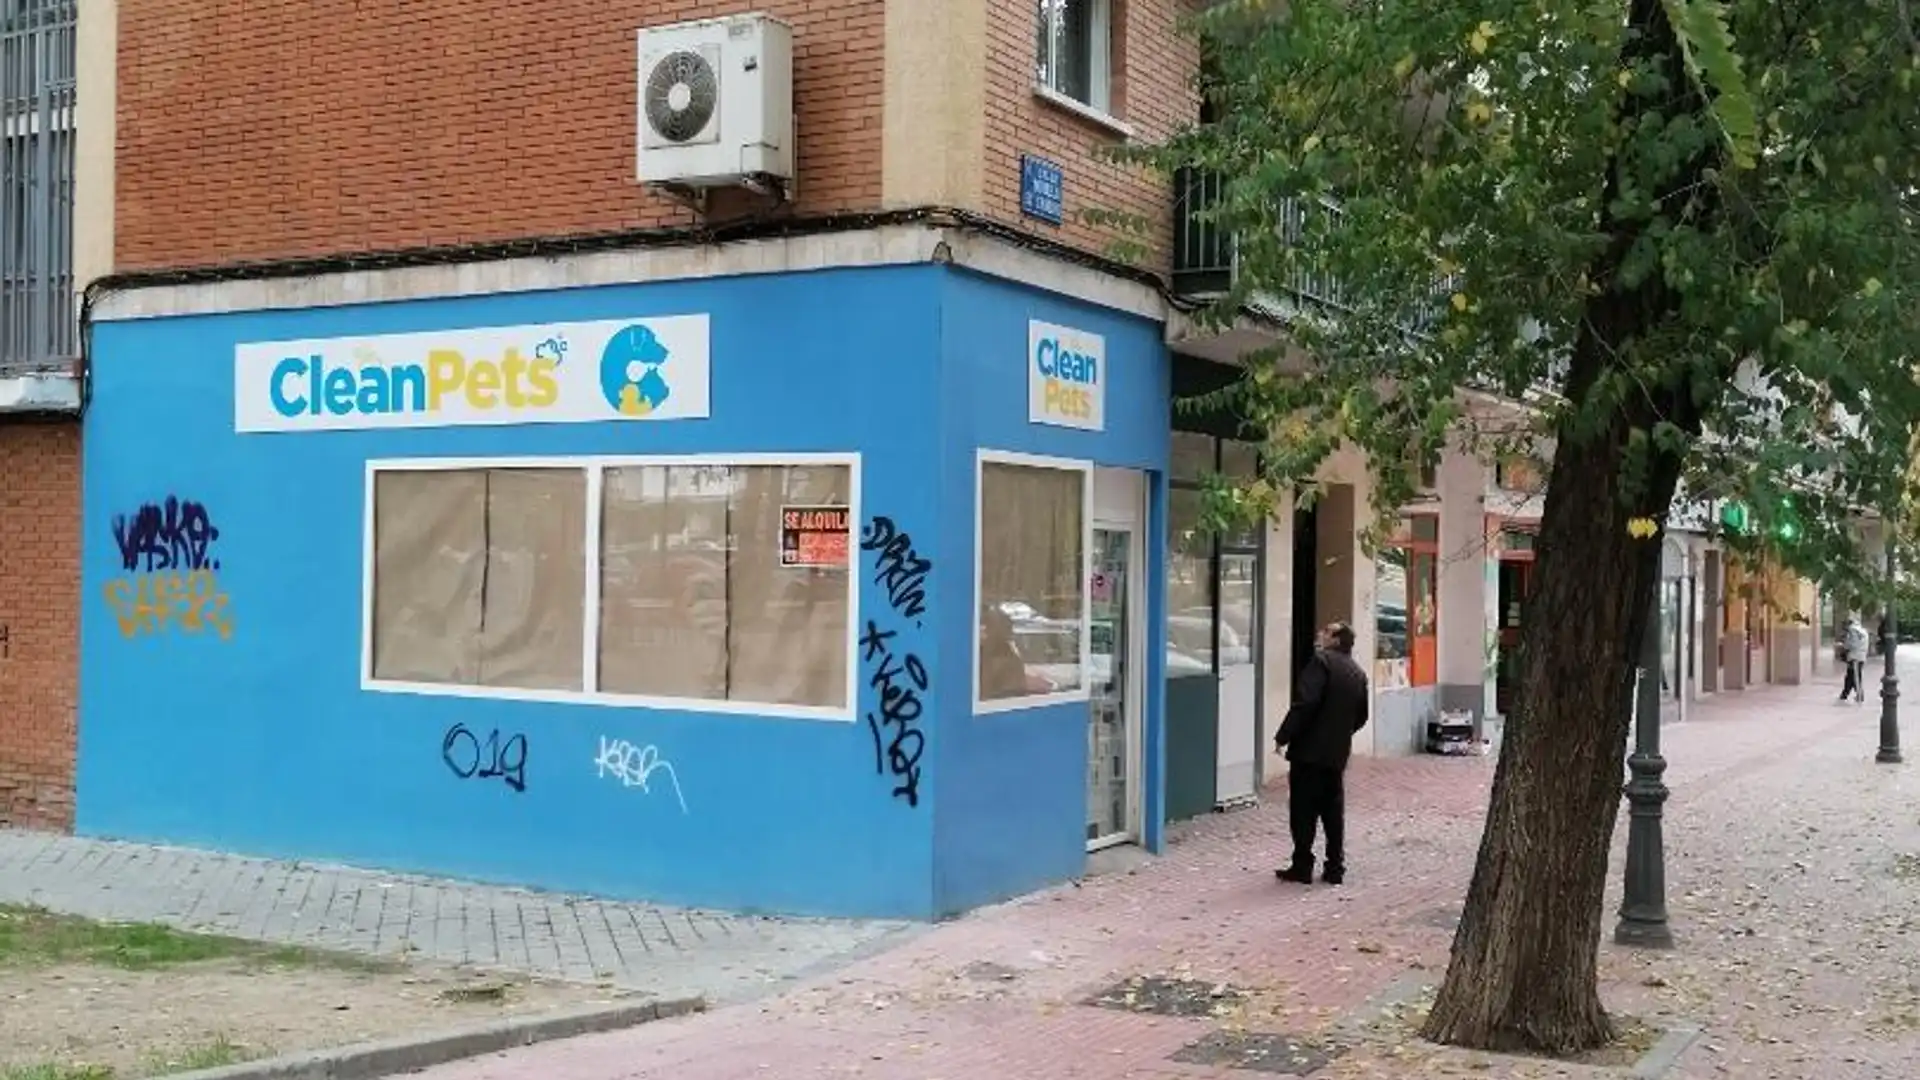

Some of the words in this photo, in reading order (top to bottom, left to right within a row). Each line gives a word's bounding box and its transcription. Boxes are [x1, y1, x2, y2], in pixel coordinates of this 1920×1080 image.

[270, 347, 558, 418] CleanPets
[1037, 338, 1097, 385] Clean
[1044, 380, 1091, 420] Pets
[784, 511, 799, 529] SE
